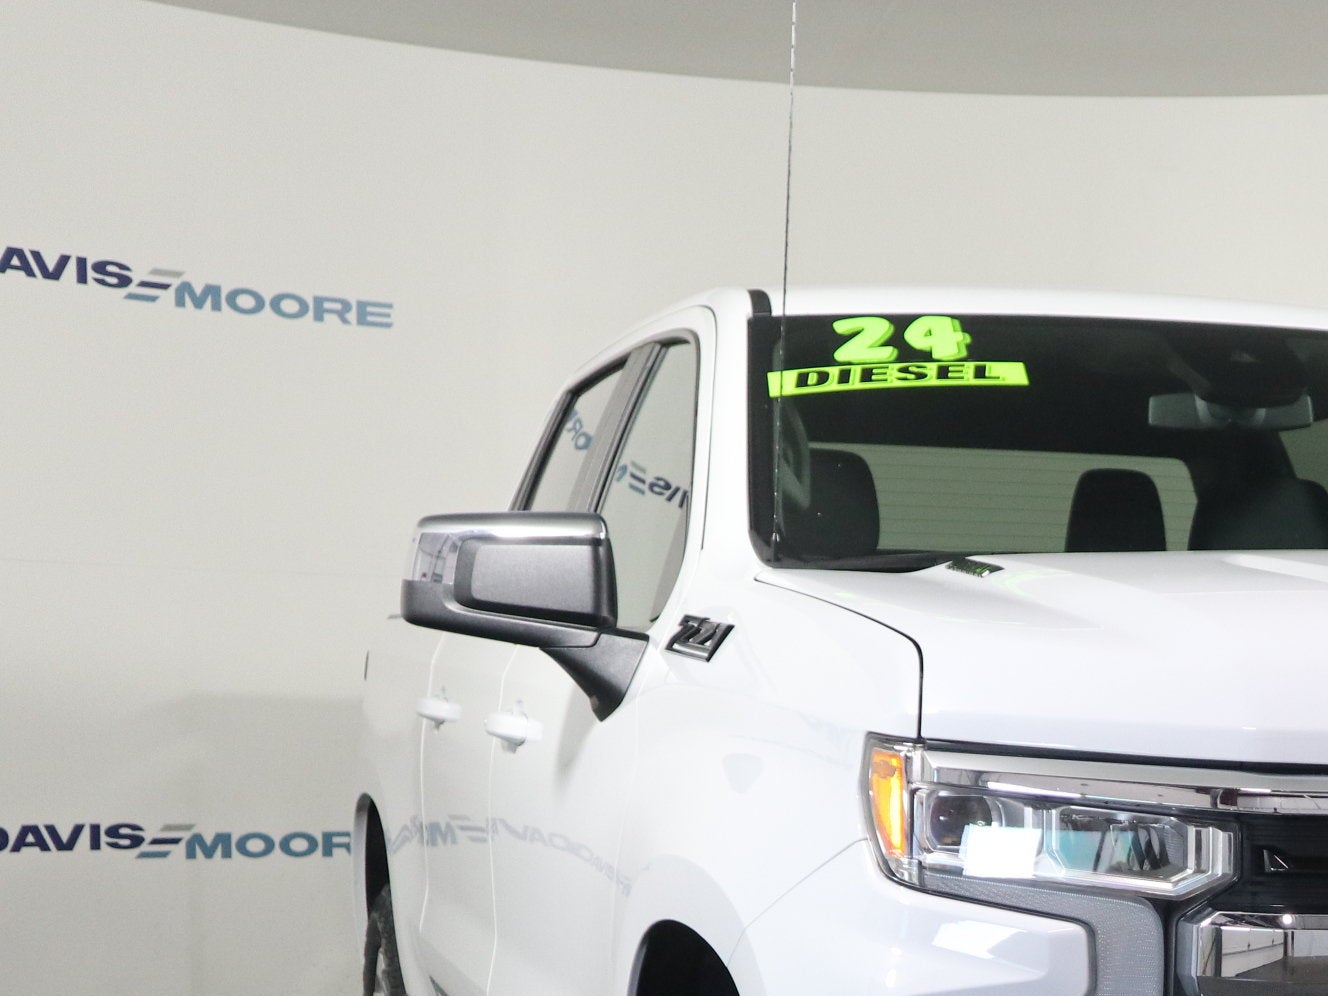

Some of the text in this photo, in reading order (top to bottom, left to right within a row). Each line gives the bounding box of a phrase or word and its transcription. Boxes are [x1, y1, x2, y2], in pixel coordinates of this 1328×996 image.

[0, 246, 394, 329] AVIS MOORE
[832, 315, 972, 362] 24
[794, 362, 1006, 389] DIESEL
[0, 823, 352, 860] AVIS MOOR
